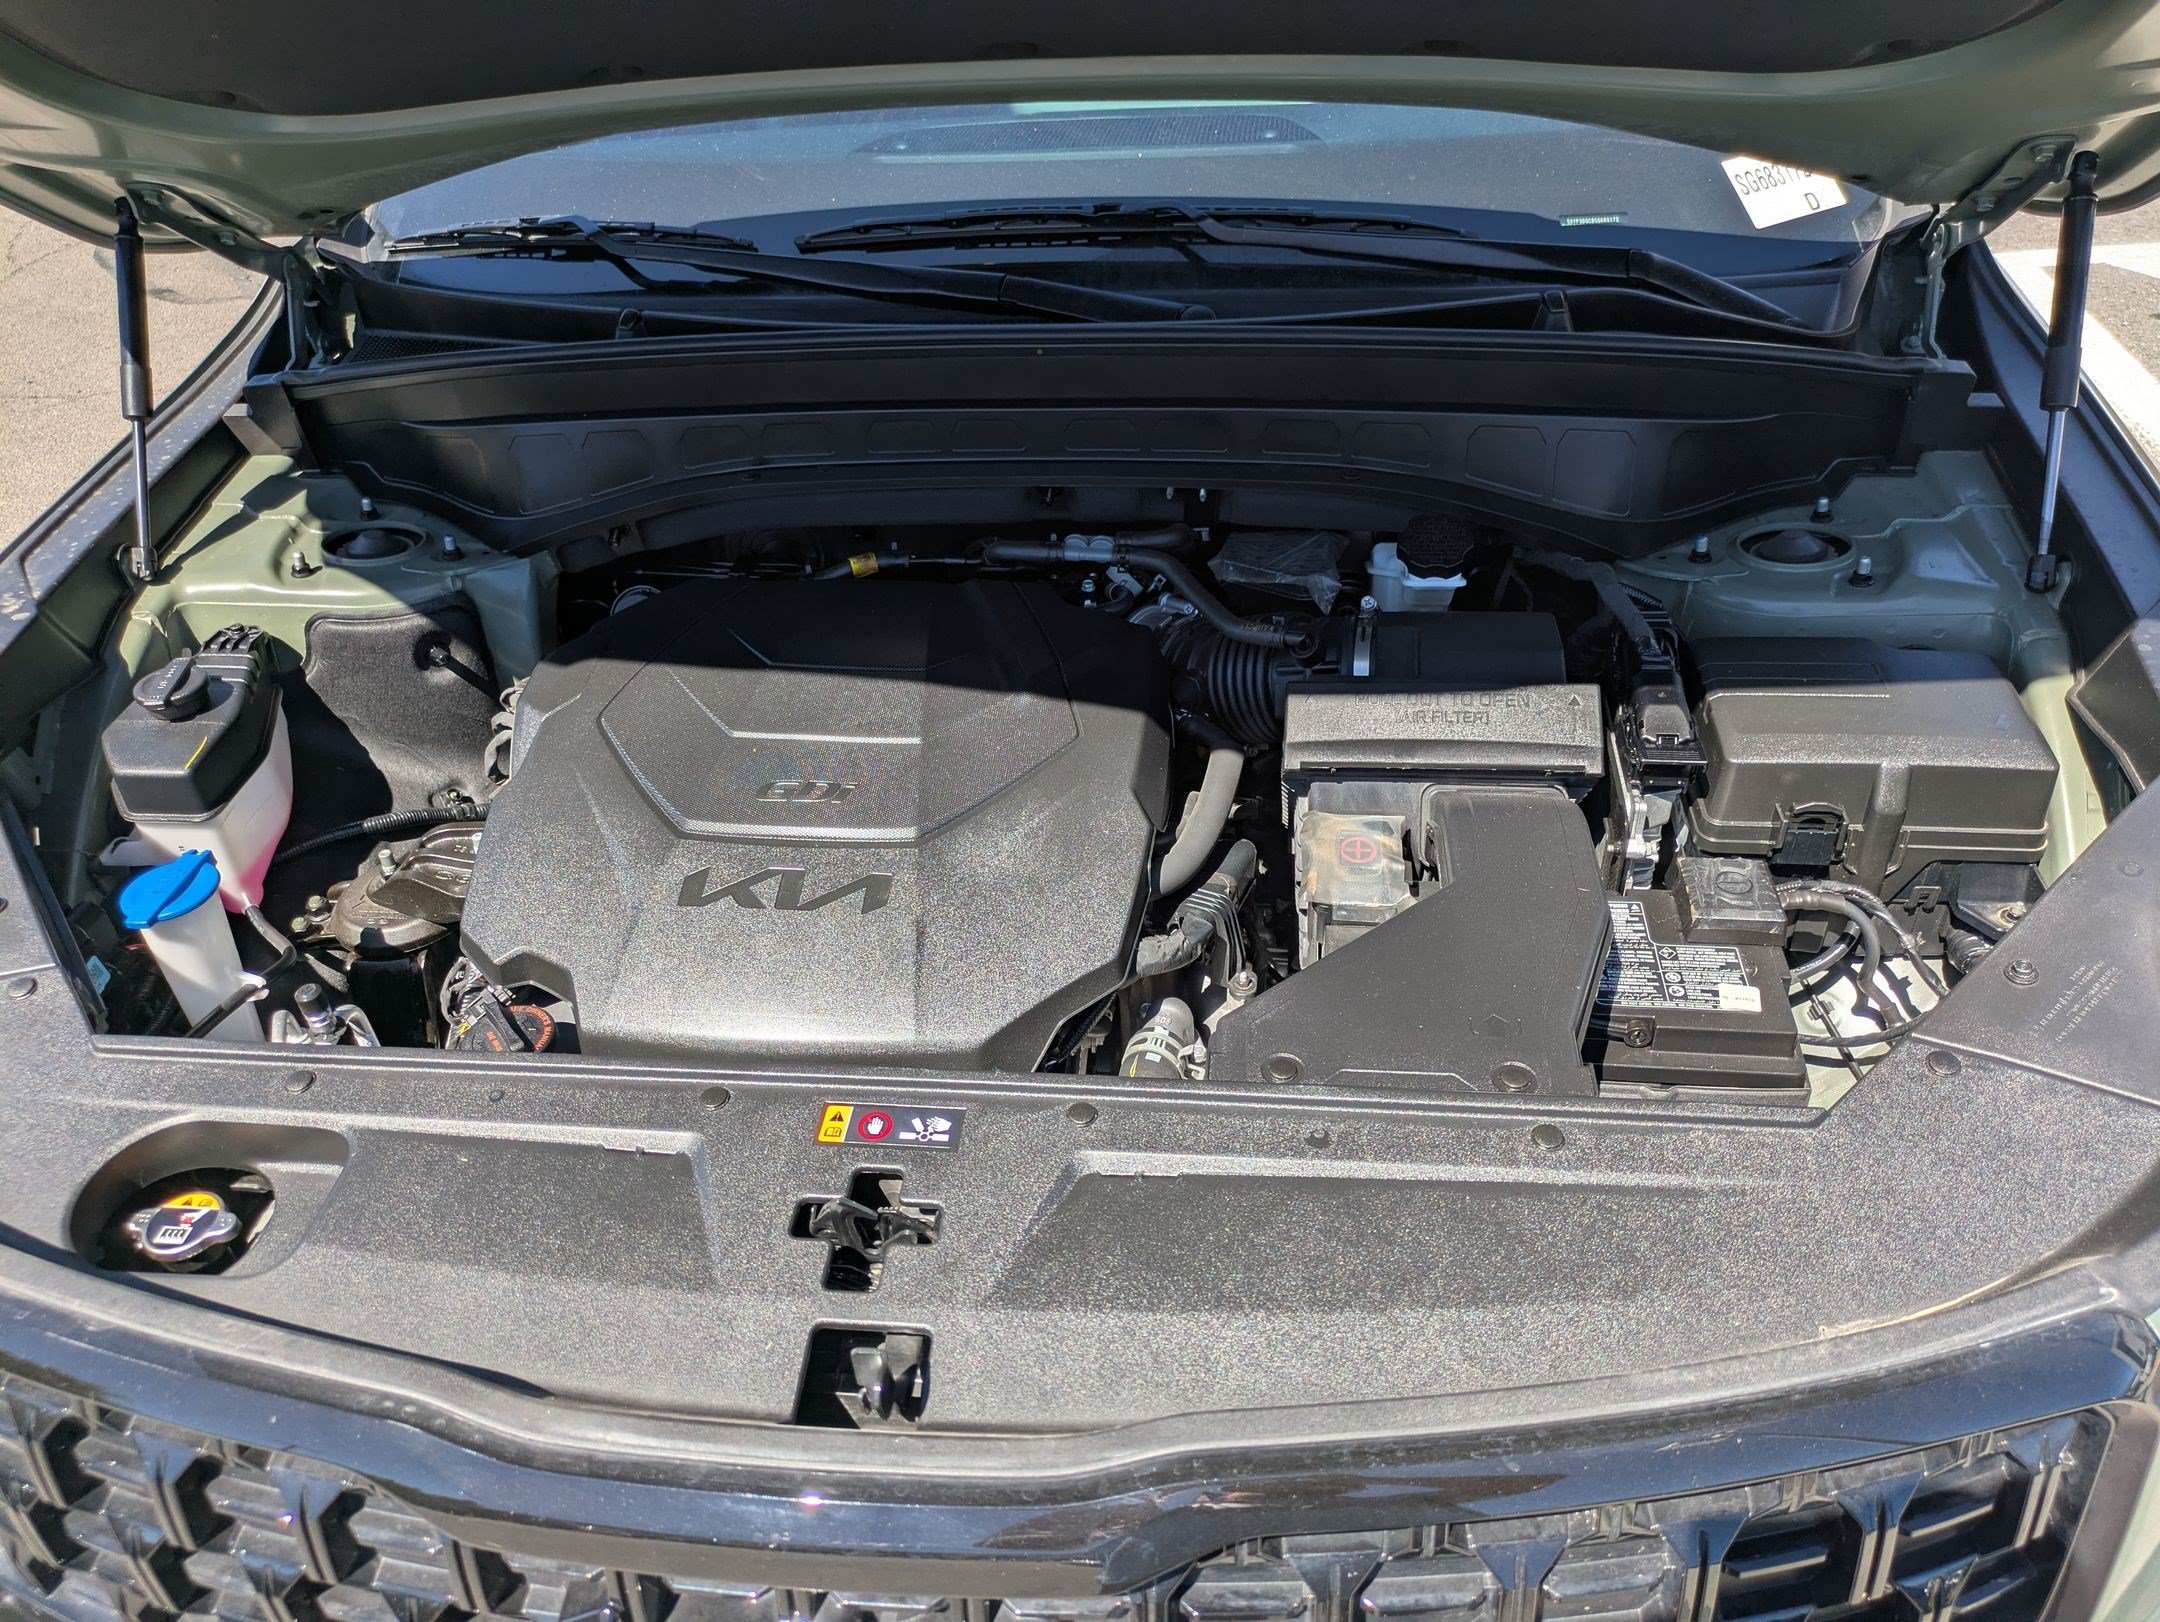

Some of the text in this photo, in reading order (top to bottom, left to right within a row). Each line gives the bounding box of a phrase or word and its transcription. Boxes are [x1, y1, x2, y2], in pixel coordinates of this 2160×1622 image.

[1804, 192, 1821, 211] D
[1479, 692, 1530, 708] OPEN
[677, 866, 895, 914] KIA
